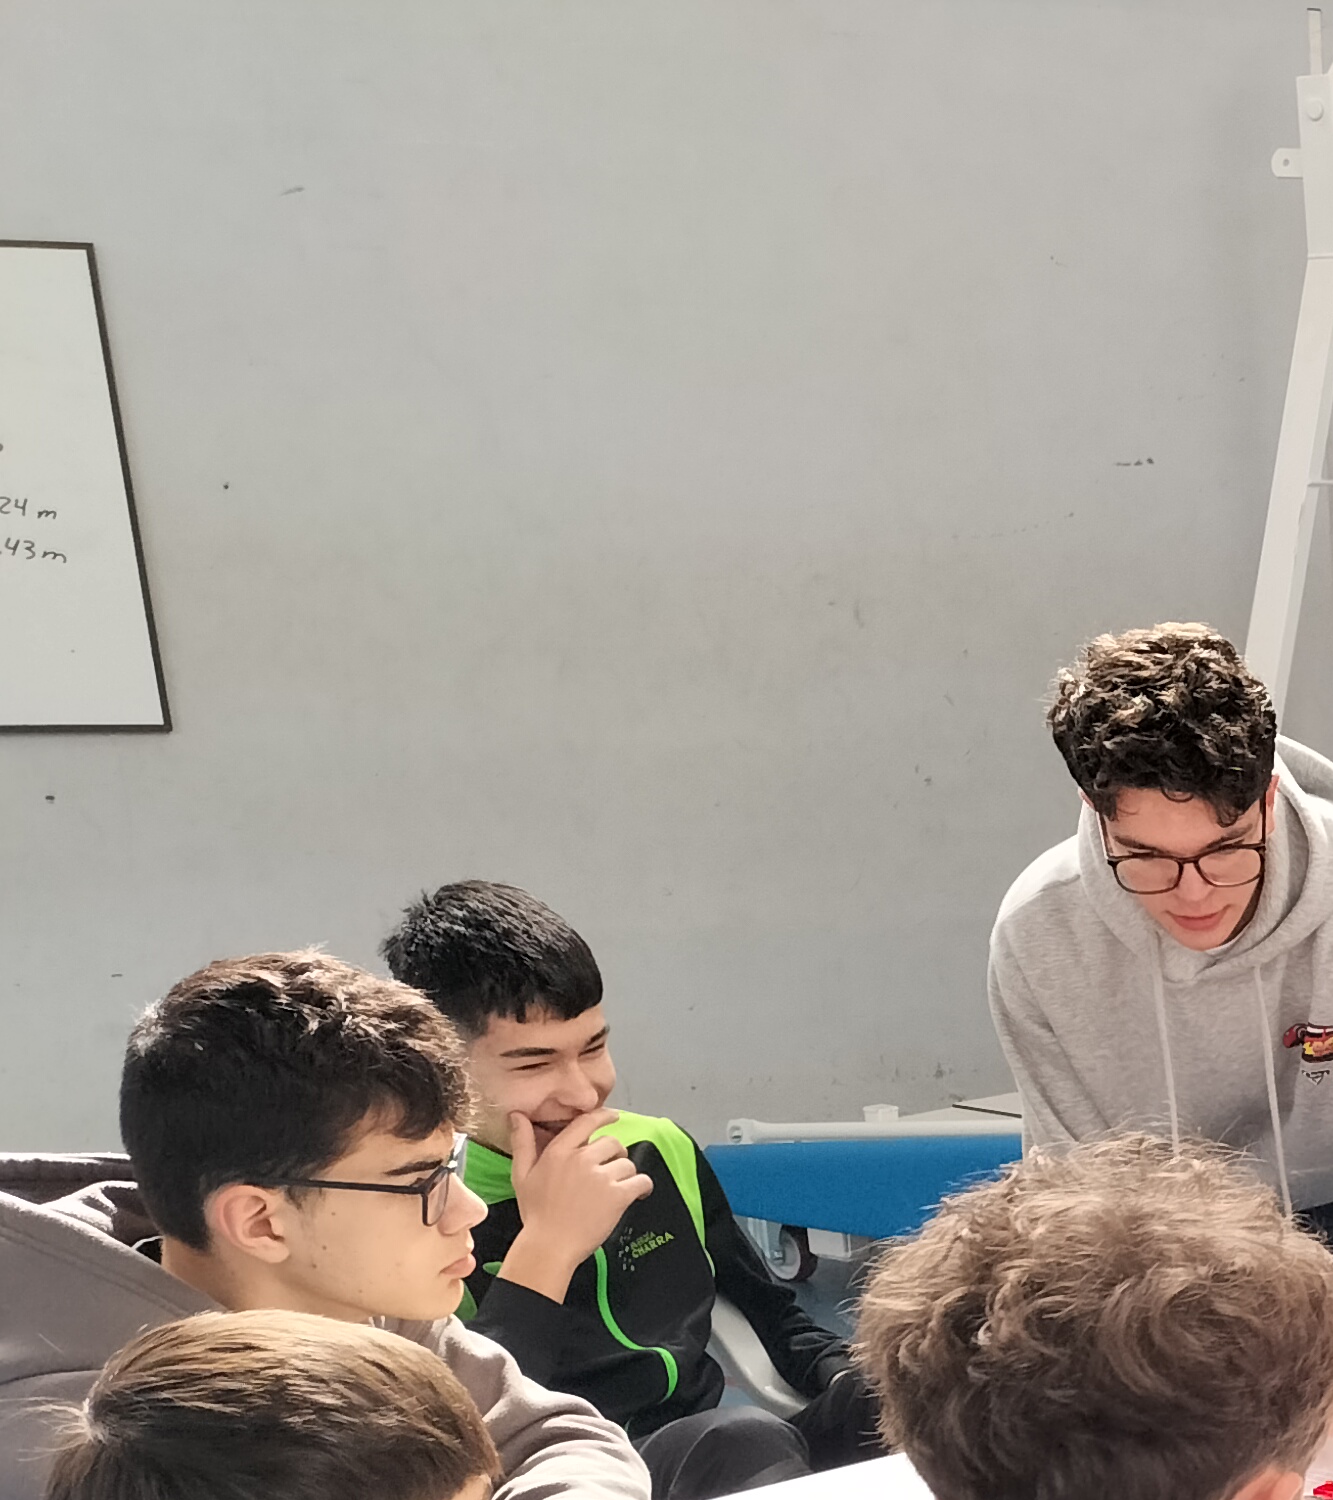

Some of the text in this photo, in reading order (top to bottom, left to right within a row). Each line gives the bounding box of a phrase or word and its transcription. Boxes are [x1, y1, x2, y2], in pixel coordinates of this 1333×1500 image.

[37, 509, 57, 520] m
[41, 550, 67, 564] m
[631, 1231, 675, 1259] CHARRA
